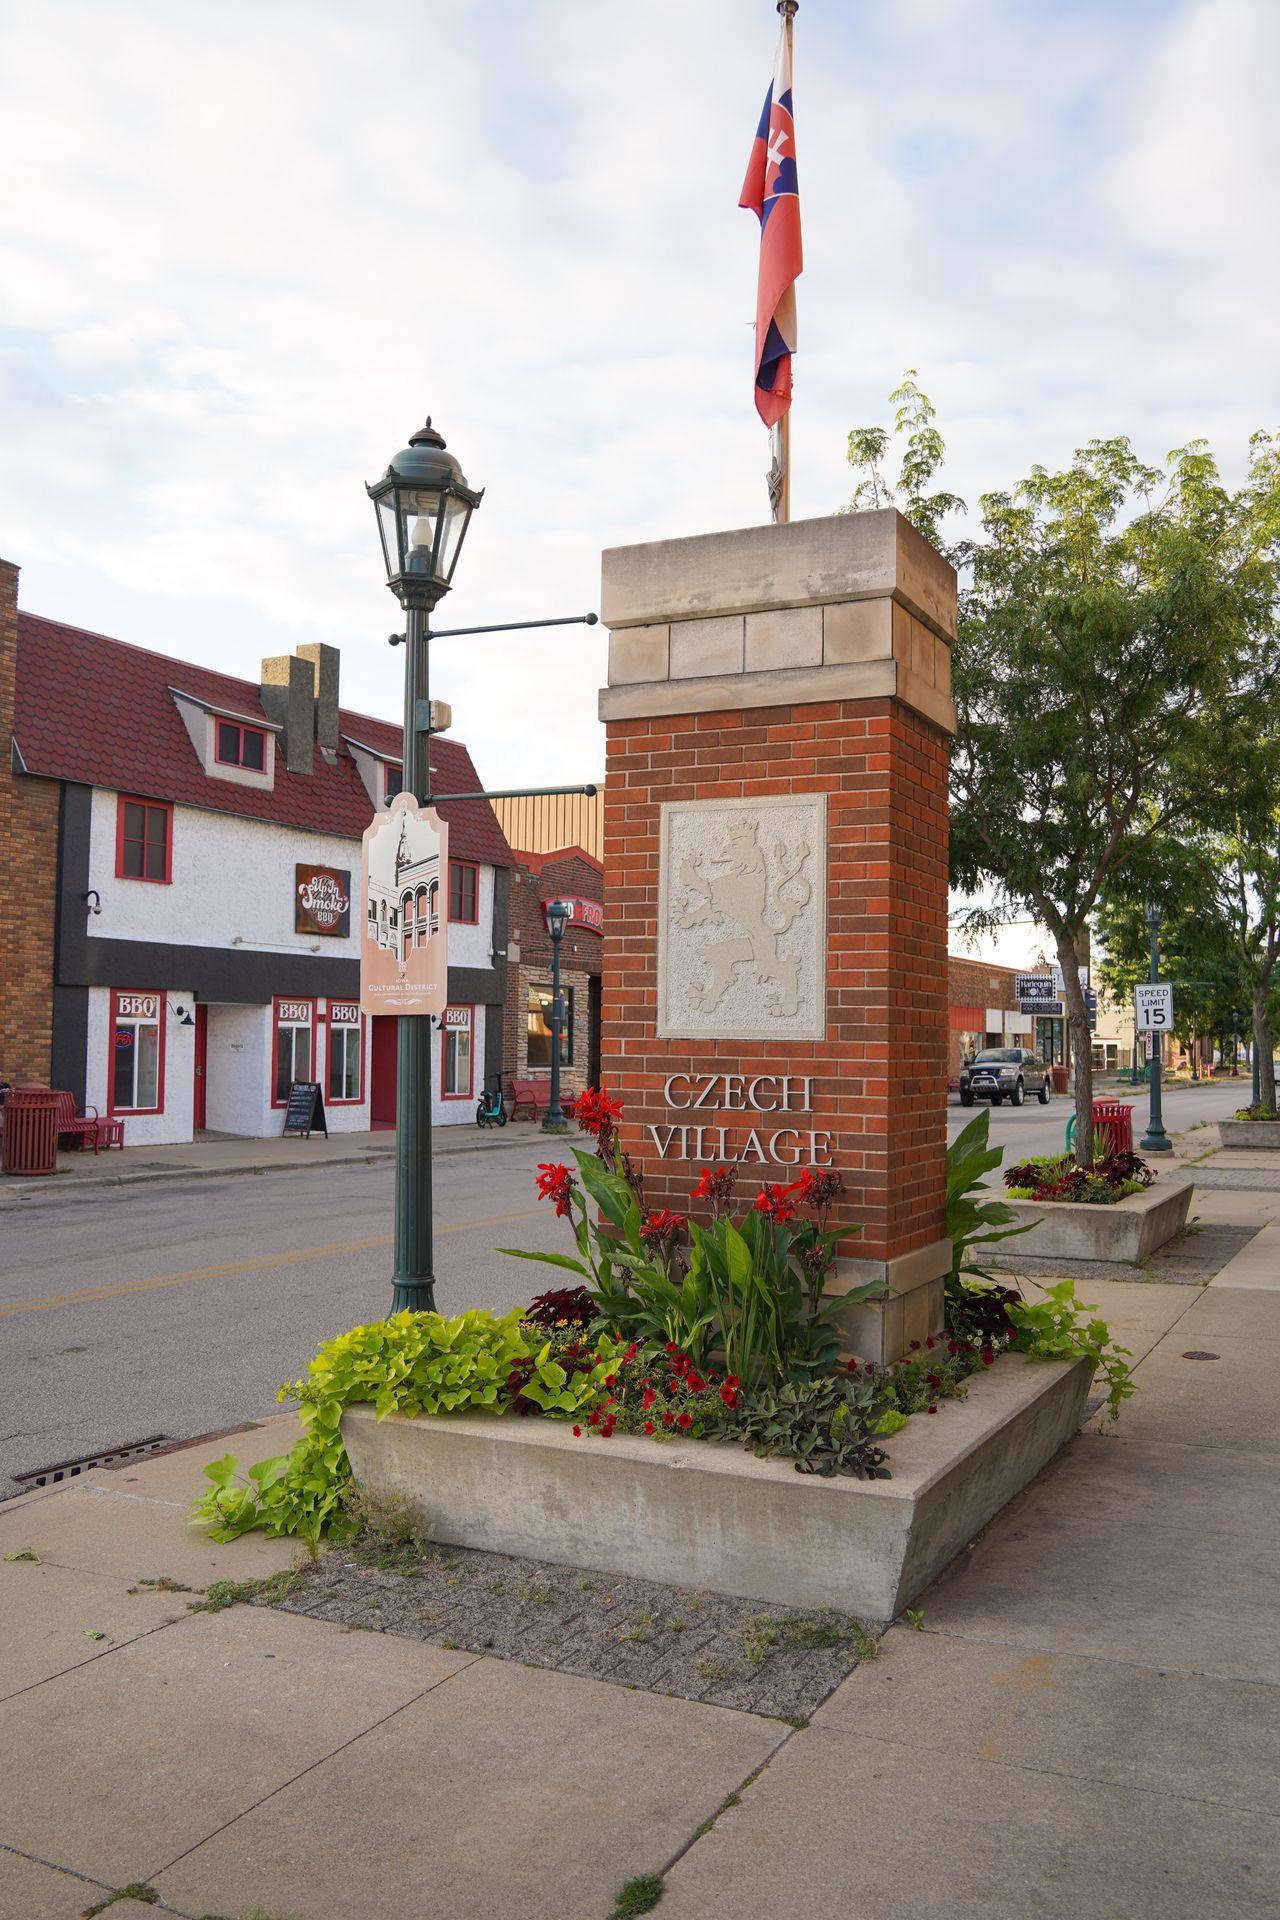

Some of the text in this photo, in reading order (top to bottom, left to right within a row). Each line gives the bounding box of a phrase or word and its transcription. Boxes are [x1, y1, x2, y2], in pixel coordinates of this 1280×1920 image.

[308, 876, 343, 901] Up In
[298, 883, 349, 912] Smoke
[317, 911, 333, 923] BBQ
[368, 983, 438, 992] CULTURAL DISTRICT
[1020, 980, 1052, 989] Harlequin
[1024, 988, 1048, 996] HOME
[1138, 989, 1169, 997] SPEED
[119, 997, 154, 1016] BBQ
[279, 1004, 307, 1021] BBQ
[332, 1006, 357, 1022] BBQ
[446, 1010, 467, 1024] BBQ
[1144, 1009, 1166, 1025] 15
[663, 1073, 814, 1112] CZECH
[647, 1125, 833, 1166] VILLAGE
